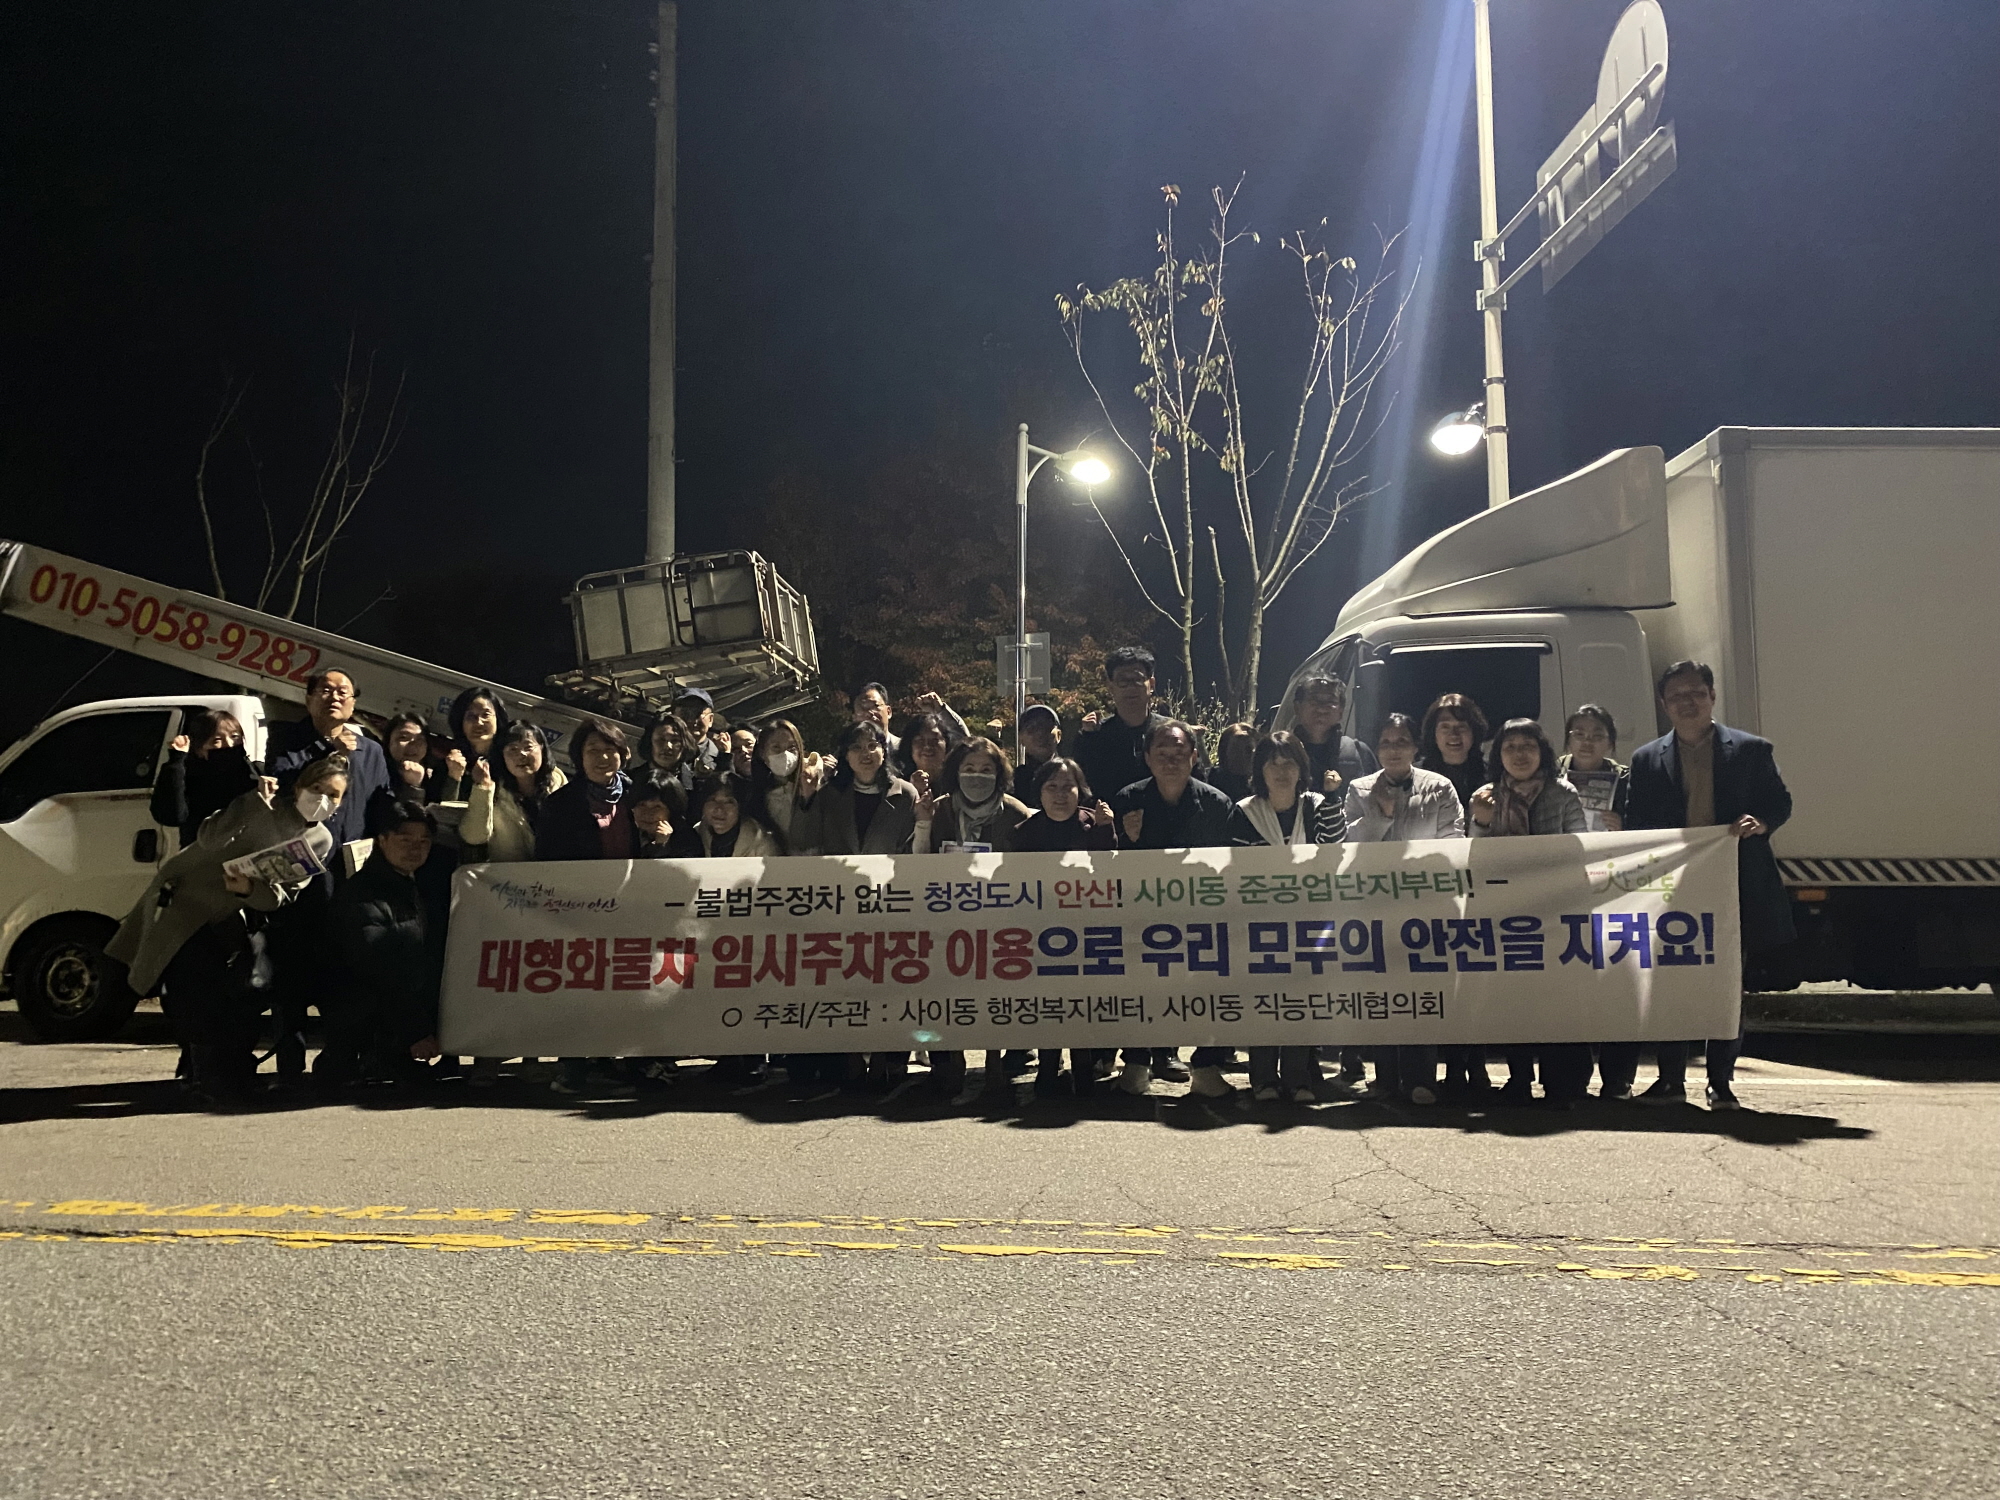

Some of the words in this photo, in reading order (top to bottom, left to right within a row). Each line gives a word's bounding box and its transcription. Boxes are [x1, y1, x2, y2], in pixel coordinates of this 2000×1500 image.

[29, 564, 320, 682] 010-5058-9282
[587, 897, 621, 913] 안산
[694, 884, 846, 919] 불법주정차
[854, 883, 914, 915] 없는
[924, 880, 1043, 913] 청정도시
[1053, 878, 1124, 910] 안산!
[1134, 874, 1228, 907] 사이동
[1237, 868, 1475, 904] 준공업단지부터!
[476, 937, 699, 994] 대형화물차
[711, 931, 934, 989] 임시주차장
[945, 926, 1126, 981] 이용으로
[1141, 922, 1230, 977] 우리
[1248, 919, 1387, 975] 모두의
[1400, 916, 1545, 973] 안전을
[1558, 911, 1715, 970] 지켜요!
[754, 1000, 871, 1030] 주최/주관
[899, 997, 979, 1027] 사이동
[987, 995, 1154, 1026] 행정복지센터,
[1162, 993, 1244, 1023] 사이동
[1253, 990, 1445, 1021] 직능단체협의회
